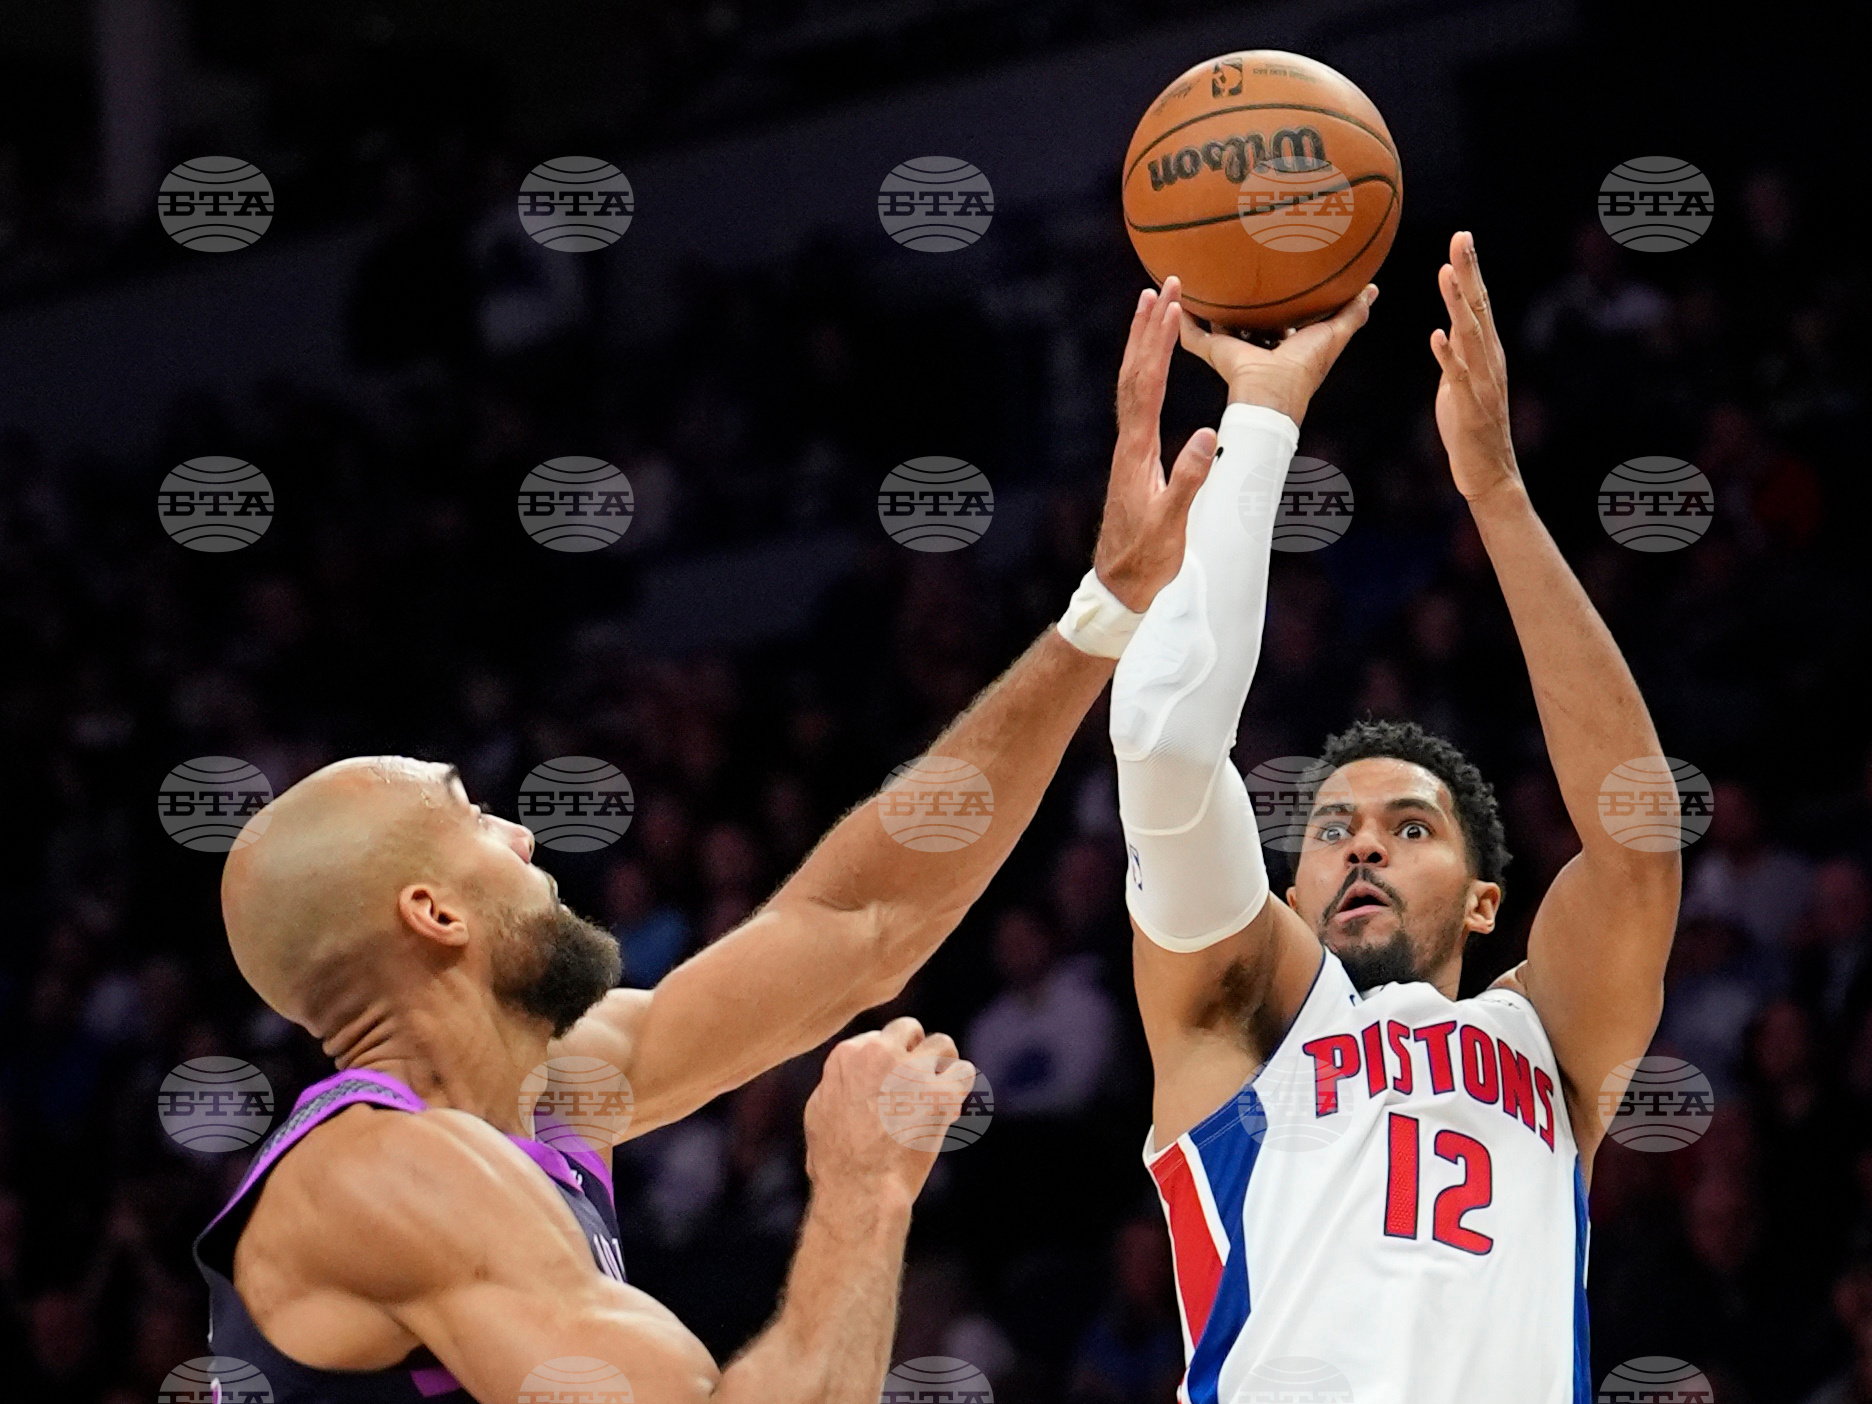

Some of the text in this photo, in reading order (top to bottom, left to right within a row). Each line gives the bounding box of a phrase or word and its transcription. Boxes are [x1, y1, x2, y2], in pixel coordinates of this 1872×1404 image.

[1147, 126, 1332, 192] Wilson
[1302, 1020, 1554, 1153] PISTONS
[1384, 1112, 1493, 1255] 12
